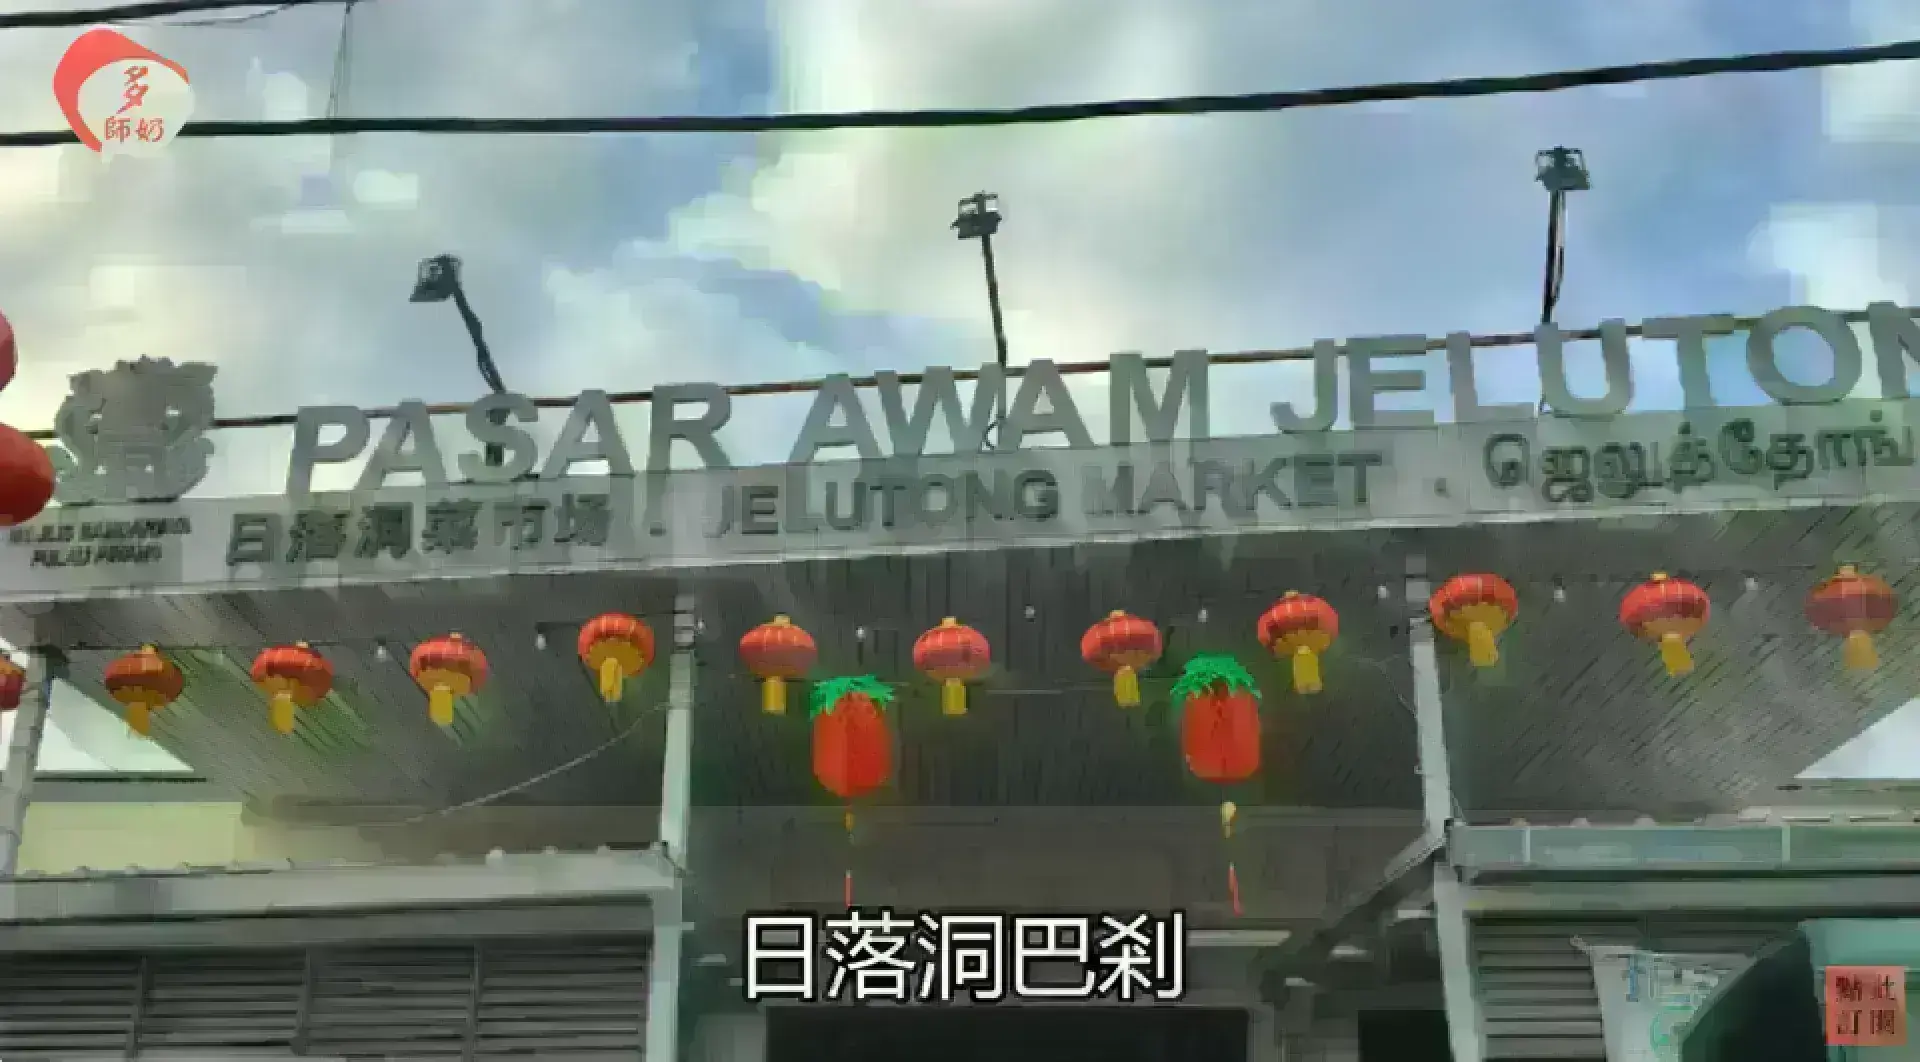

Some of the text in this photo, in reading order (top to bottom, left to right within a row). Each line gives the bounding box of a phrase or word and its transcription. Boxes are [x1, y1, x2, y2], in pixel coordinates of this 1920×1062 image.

[288, 382, 732, 493] PASAR
[787, 350, 1209, 465] AWAM
[704, 453, 1382, 537] JELUTONG MARKET
